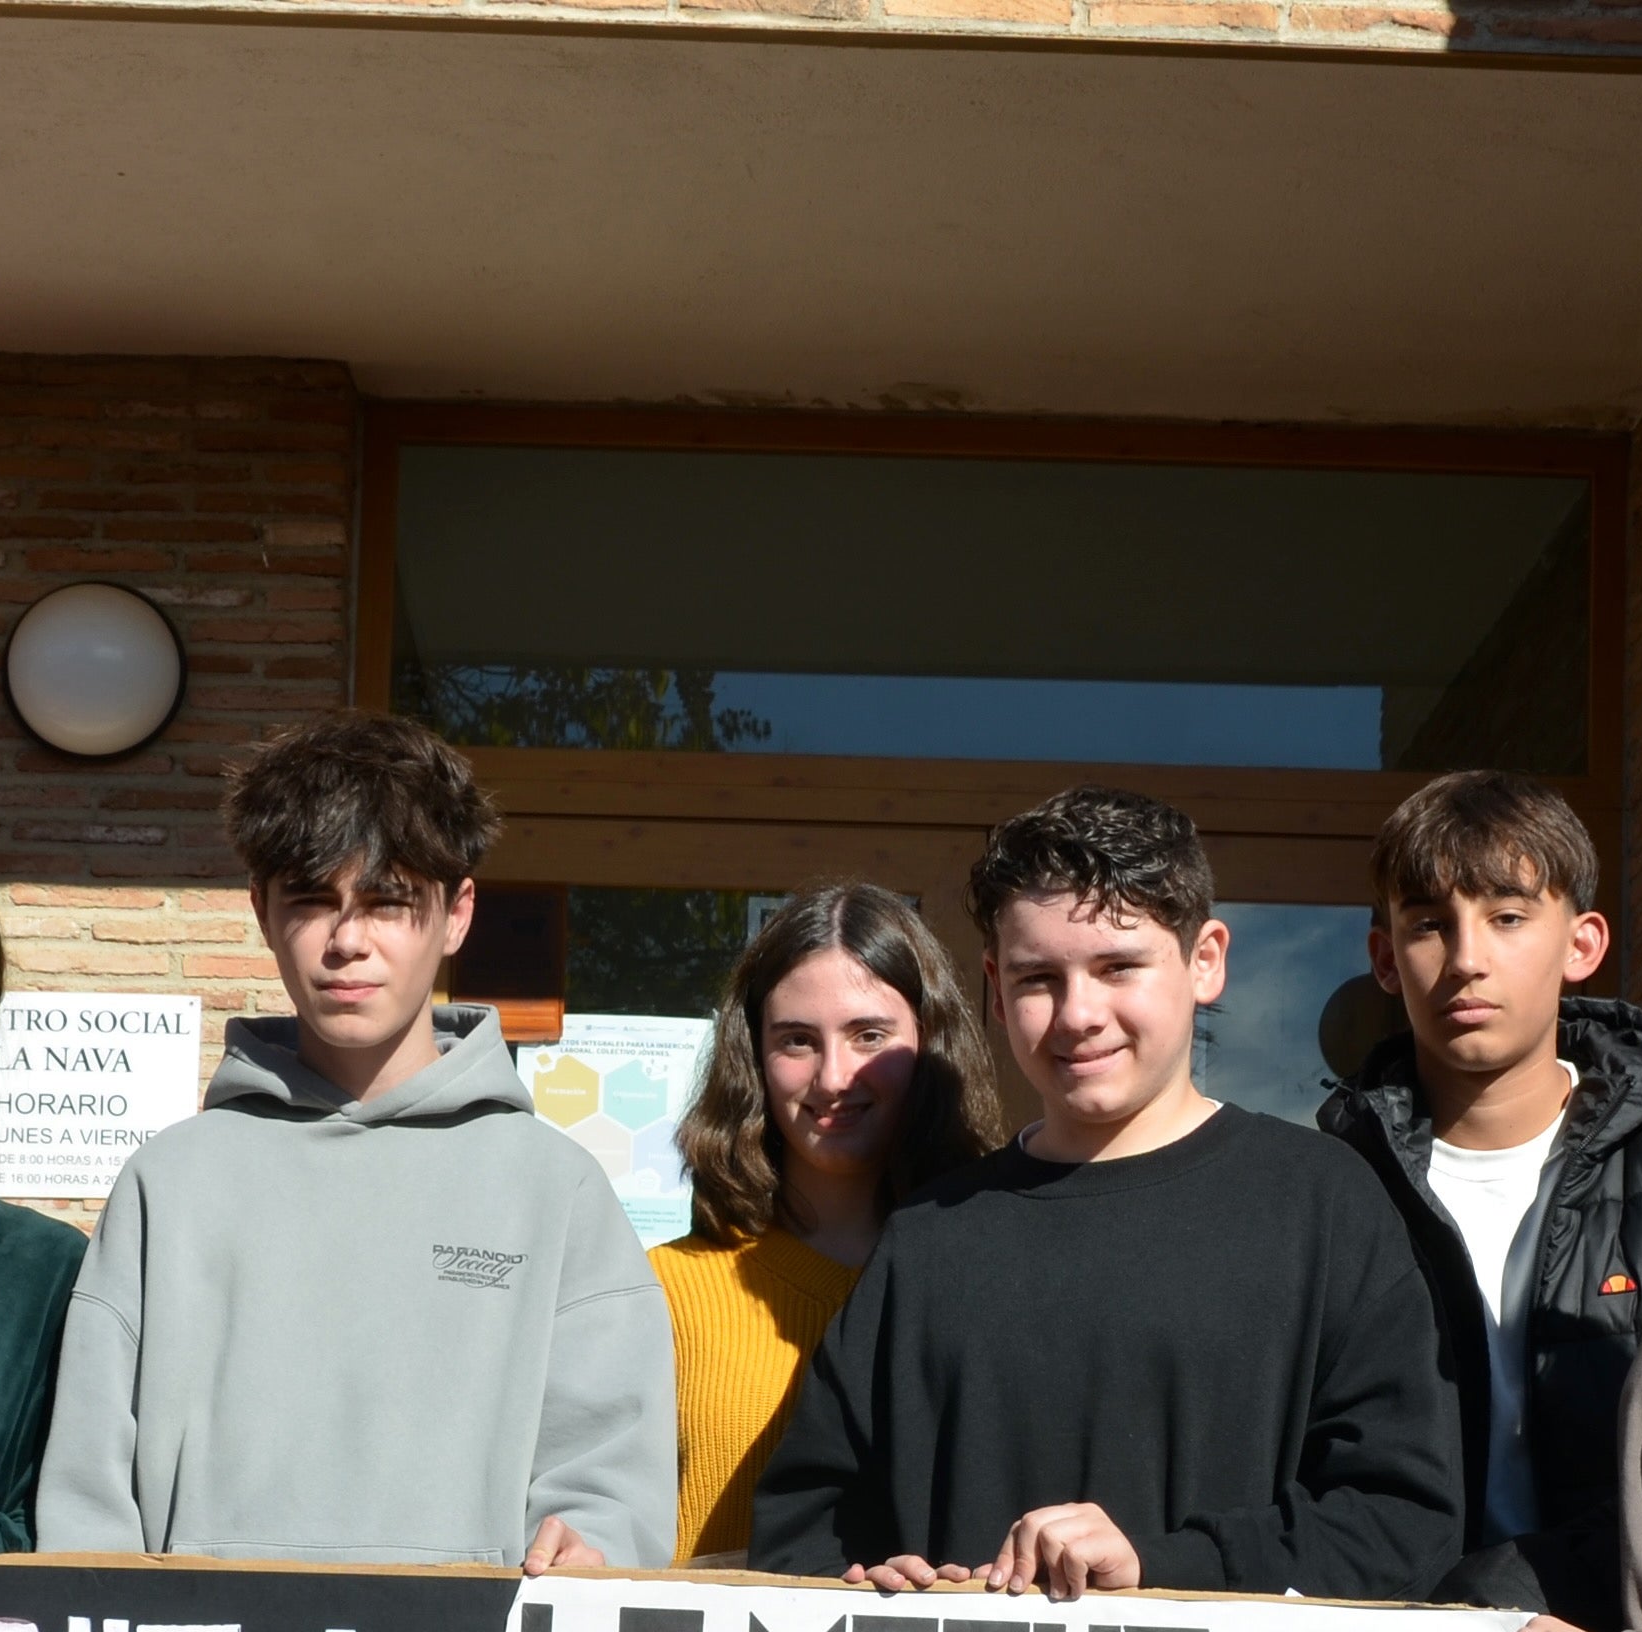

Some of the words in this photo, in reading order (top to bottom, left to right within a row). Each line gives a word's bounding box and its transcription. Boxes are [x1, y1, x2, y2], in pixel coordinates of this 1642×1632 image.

[77, 1010, 191, 1035] SOCIAL
[581, 1040, 625, 1048] INTEGRALES
[44, 1046, 134, 1073] NAVA
[59, 1129, 74, 1145] A
[80, 1129, 158, 1146] VIERNE
[47, 1155, 92, 1166] HORAS
[95, 1156, 104, 1166] A
[45, 1174, 89, 1185] HORAS
[92, 1175, 101, 1185] A
[432, 1244, 524, 1265] PARANOID
